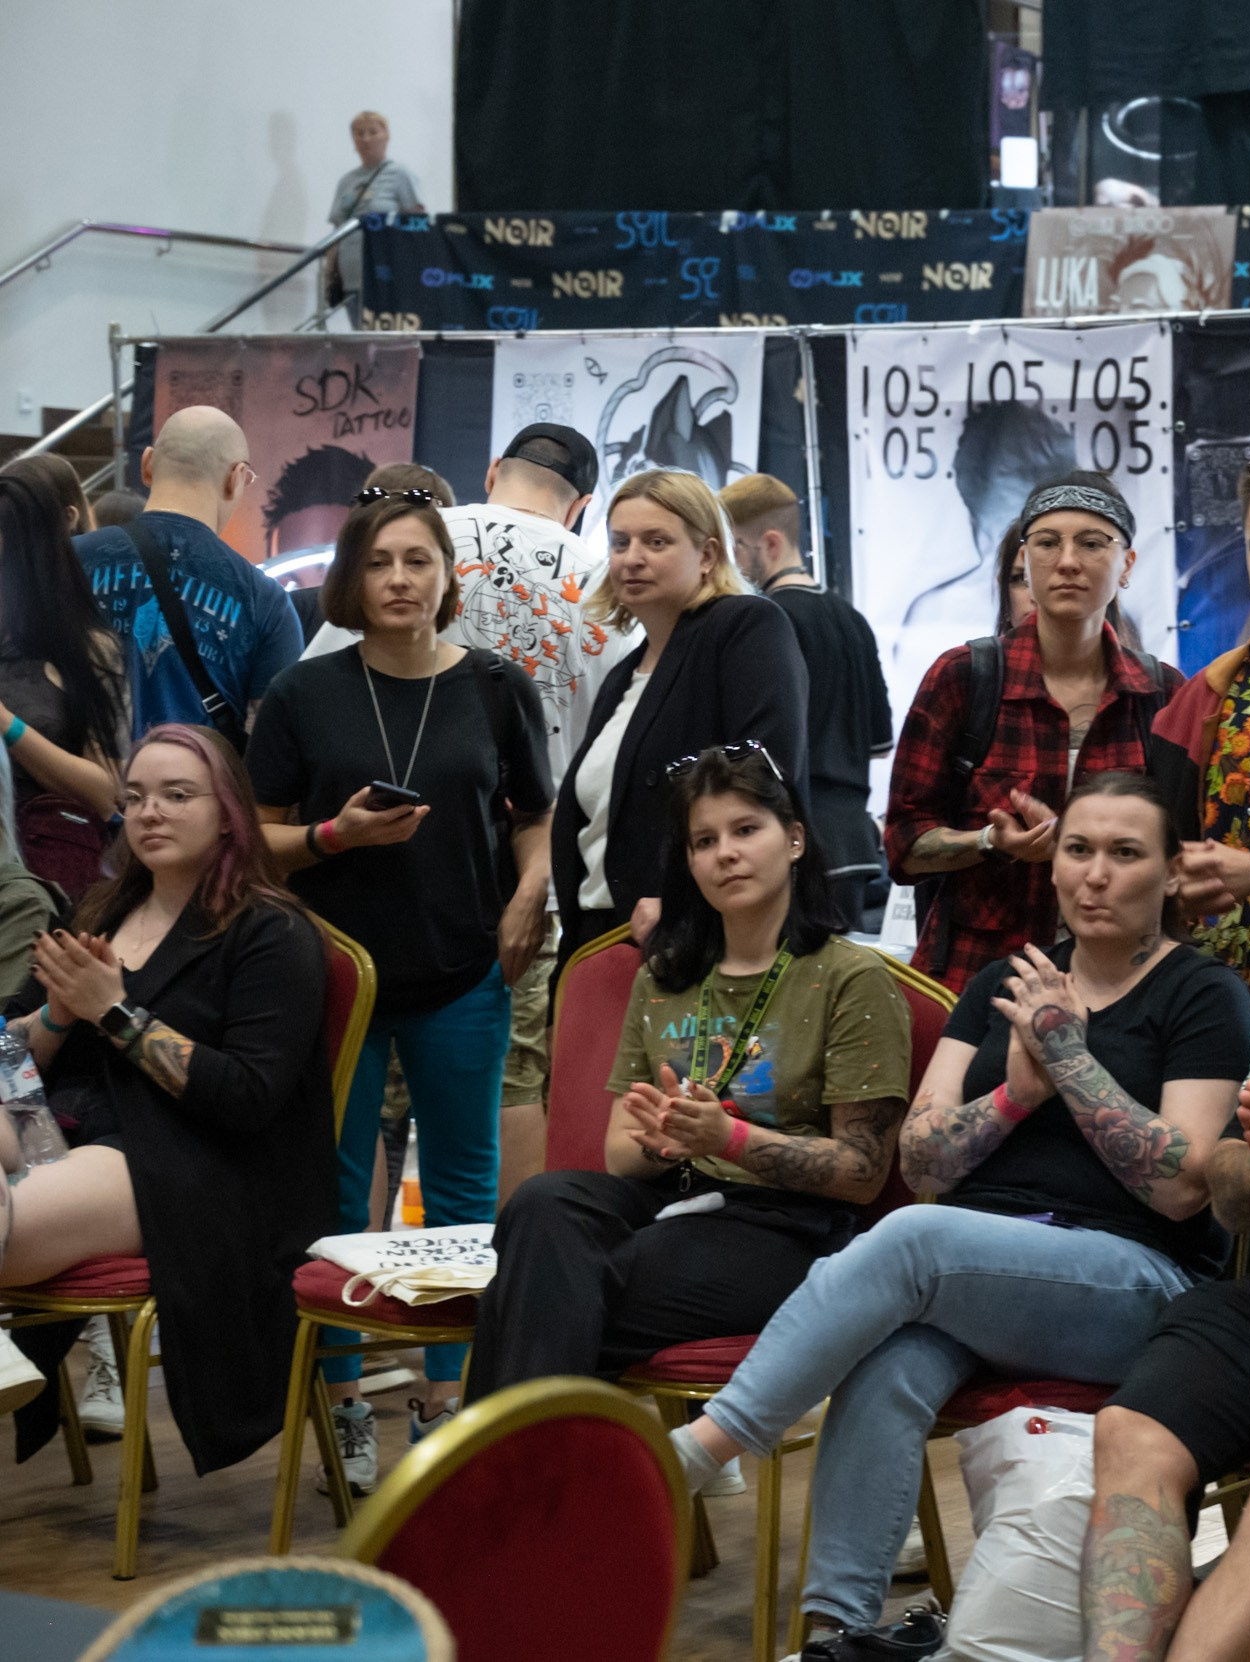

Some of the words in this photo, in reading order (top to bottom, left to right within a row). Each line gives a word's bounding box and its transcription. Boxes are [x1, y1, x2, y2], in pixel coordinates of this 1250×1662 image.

[484, 217, 555, 247] NOIR
[854, 211, 928, 240] NOIR
[552, 270, 625, 298] NOIR
[921, 261, 995, 292] NOIR
[1036, 256, 1099, 308] LUKA
[293, 363, 380, 417] SDK
[862, 365, 952, 418] 105.
[1068, 356, 1168, 412] 105.
[333, 407, 412, 439] TATTOO
[1090, 420, 1168, 475] 05.
